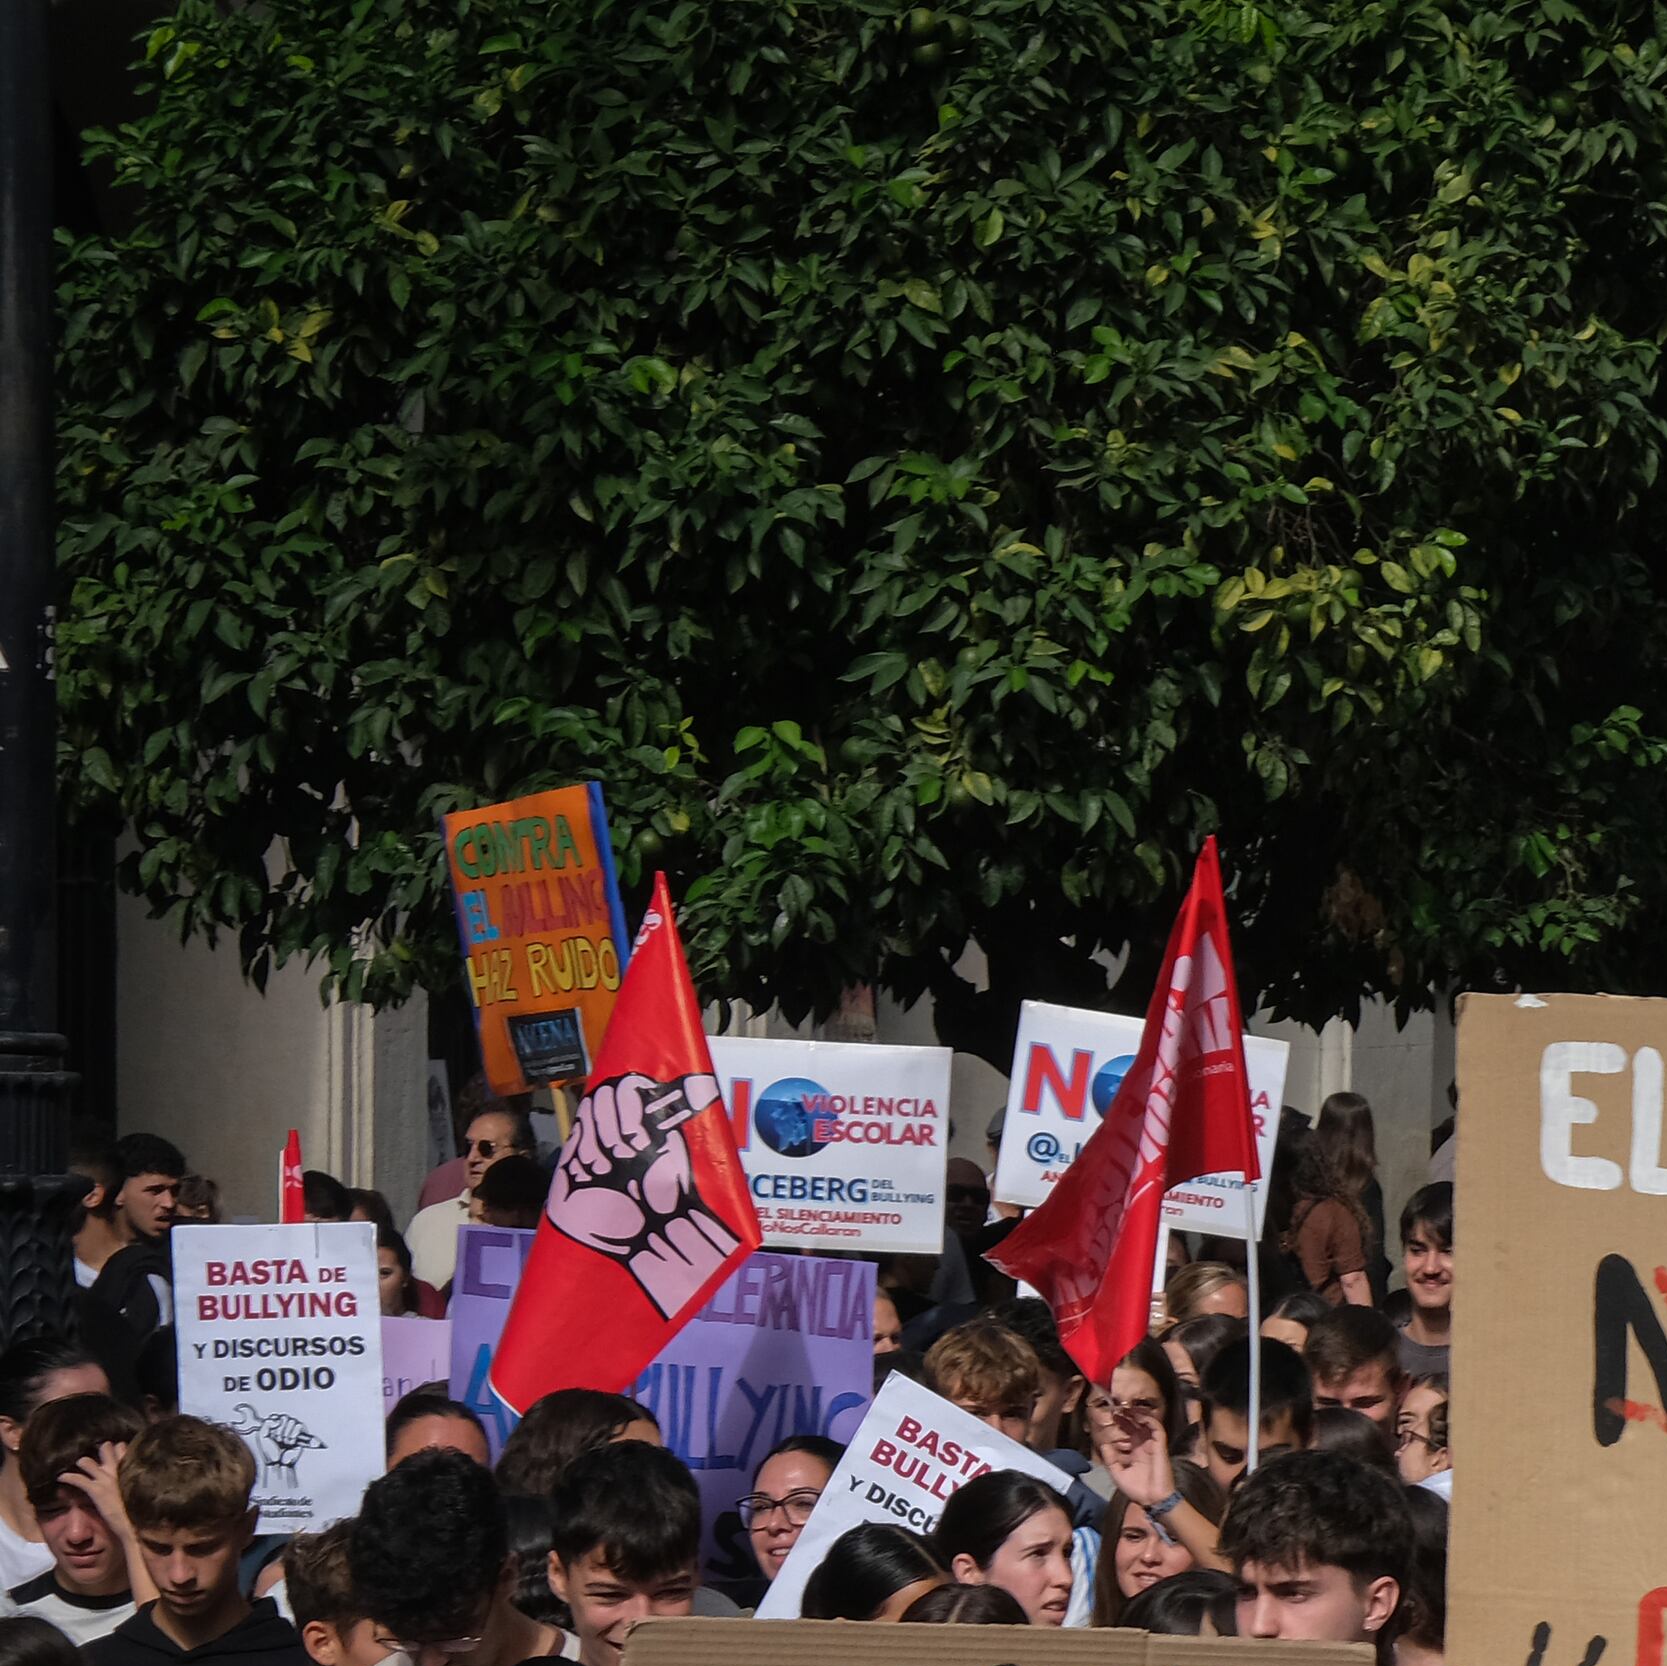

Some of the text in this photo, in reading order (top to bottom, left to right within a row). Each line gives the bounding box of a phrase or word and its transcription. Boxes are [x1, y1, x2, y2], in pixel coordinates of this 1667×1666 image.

[455, 815, 584, 879] CONTRA
[462, 890, 500, 944] EL
[465, 937, 622, 1007] HAZ RUIDO
[801, 1093, 938, 1119] VIOLENCIA
[813, 1119, 938, 1147] ESCOLAR
[747, 1172, 895, 1204] CEBERG DEL
[871, 1191, 936, 1205] BULLYING
[777, 1208, 903, 1226] SILENCIAMIENTO
[206, 1258, 347, 1287] BASTA DE
[197, 1291, 358, 1322] BULLYING
[193, 1335, 366, 1360] Y DISCURSOS
[223, 1366, 336, 1393] DE ODIO
[848, 1474, 865, 1495] Y
